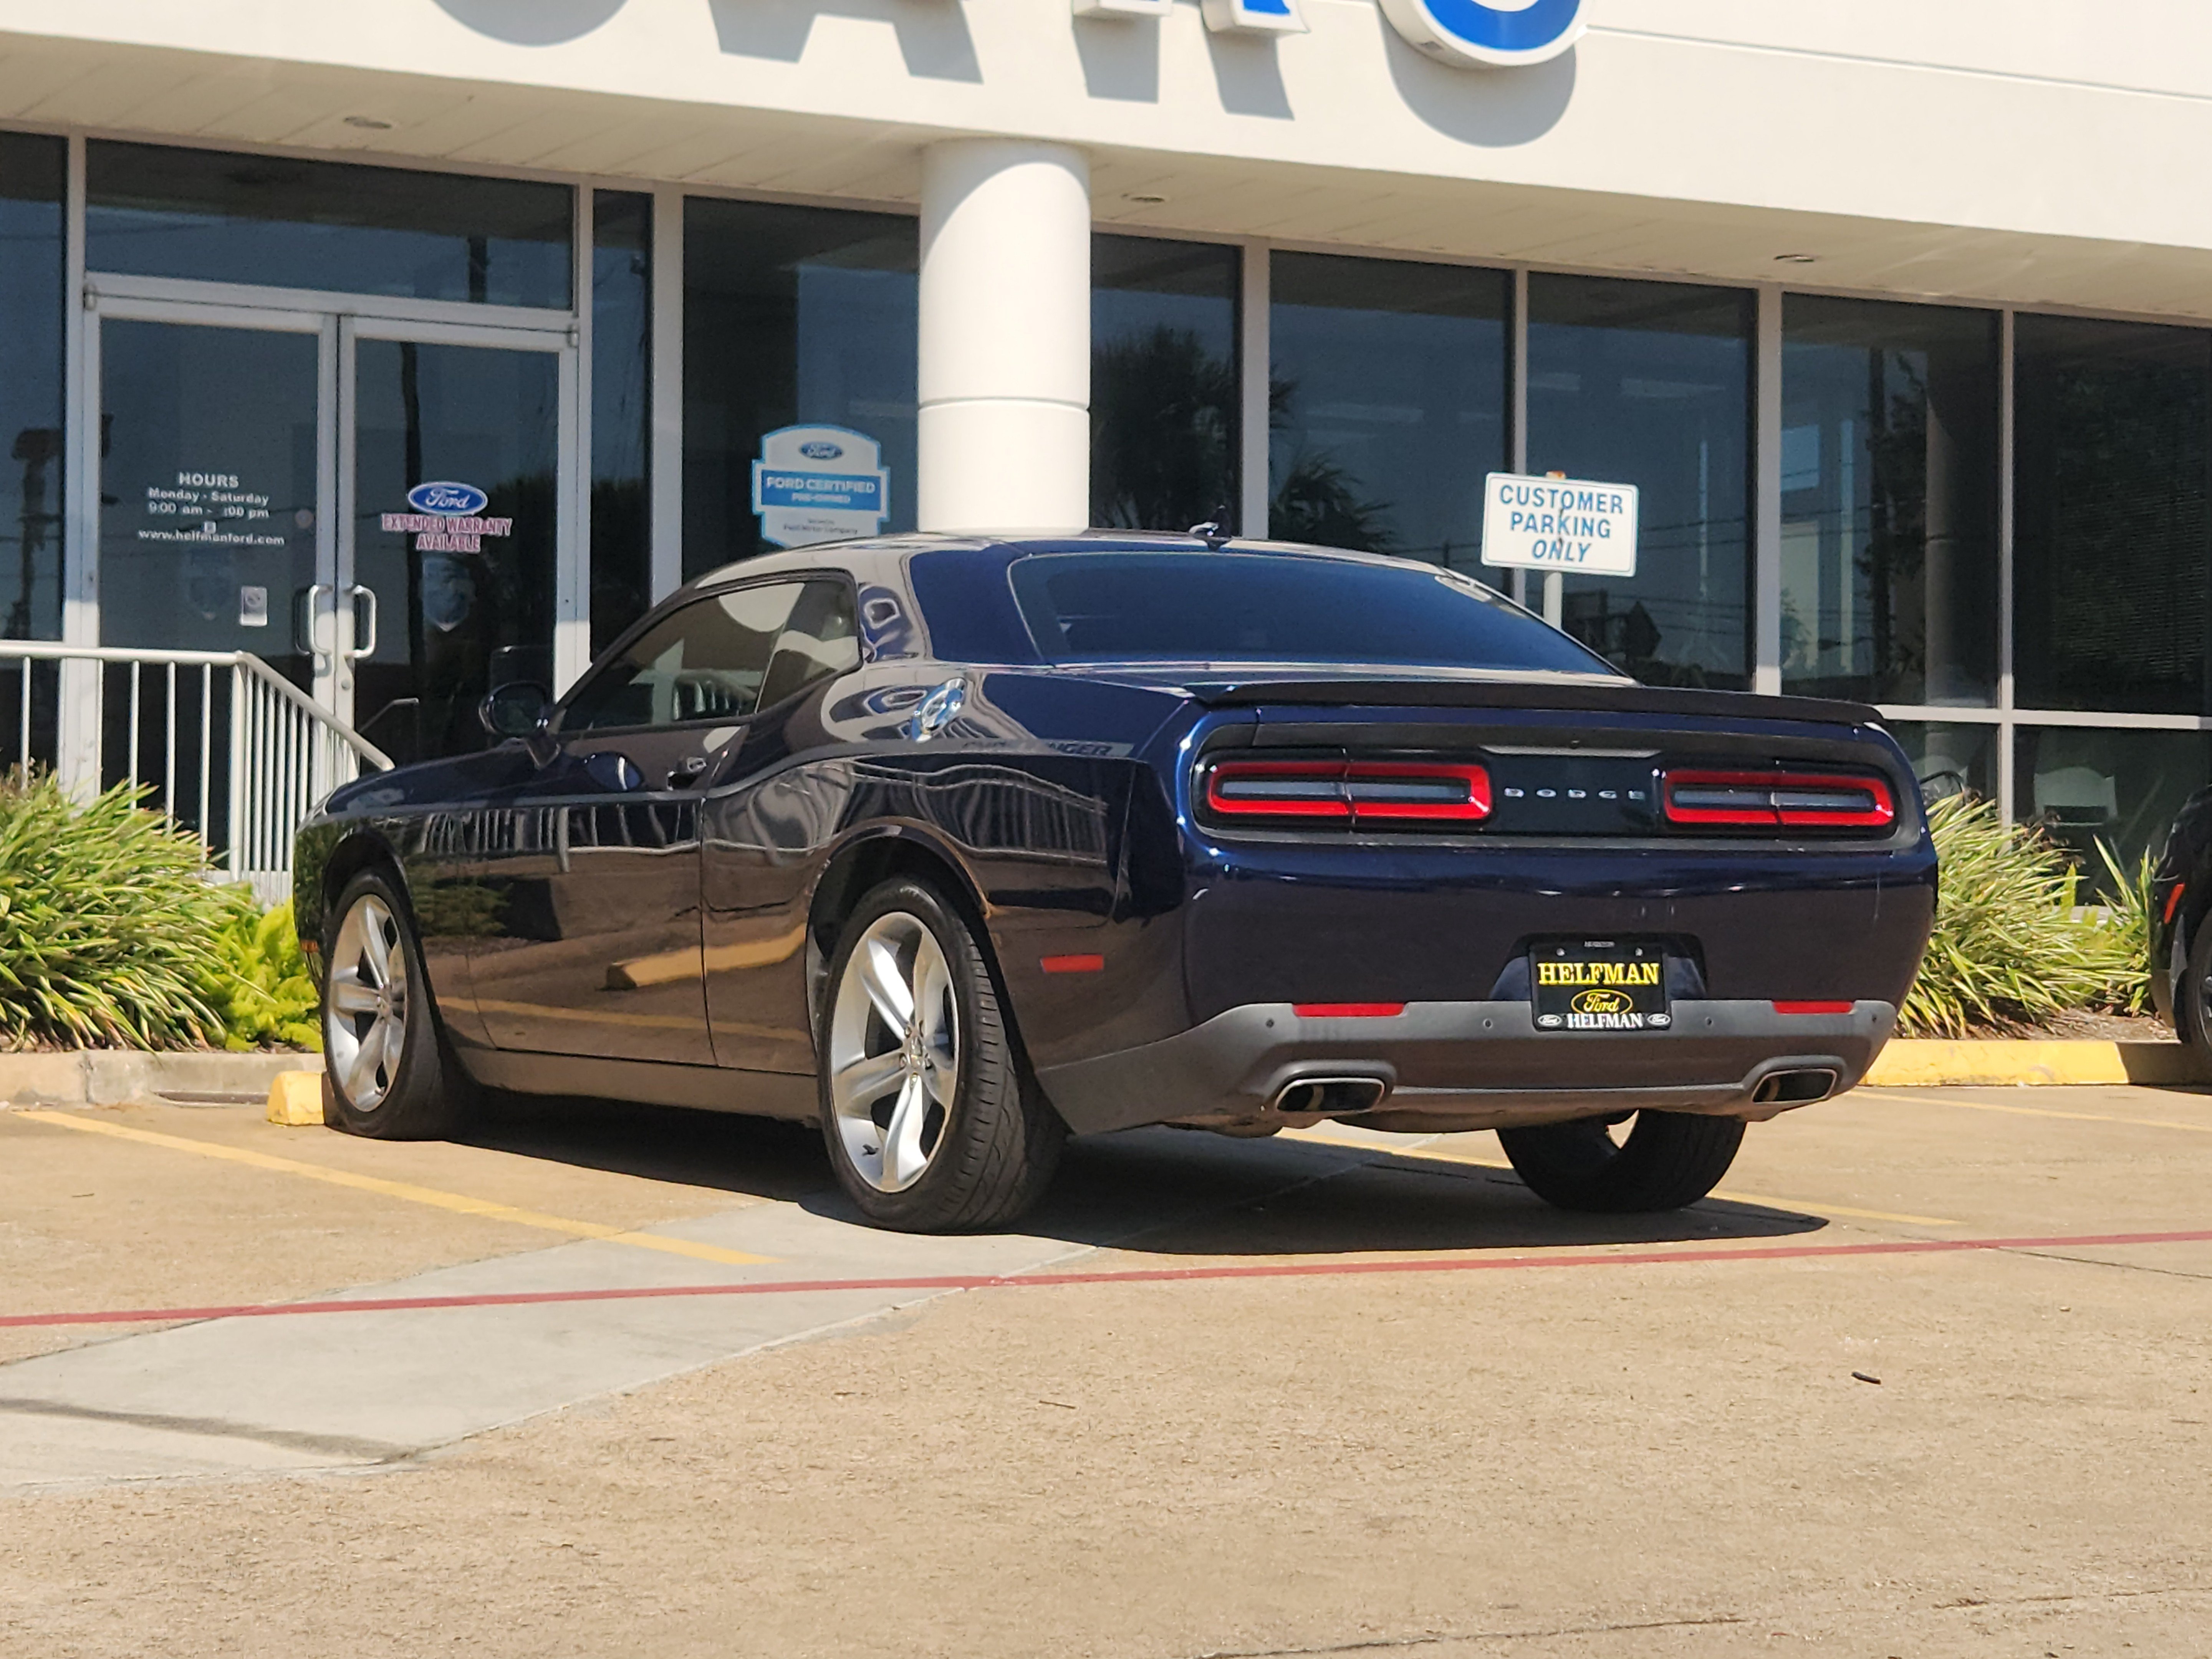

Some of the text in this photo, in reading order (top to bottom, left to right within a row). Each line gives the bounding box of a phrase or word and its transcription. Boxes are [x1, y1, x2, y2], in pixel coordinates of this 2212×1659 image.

[179, 472, 239, 488] HOURS
[766, 477, 876, 494] FORD CERTIFIED
[148, 488, 200, 503] Monday
[211, 490, 269, 506] Saturday
[424, 488, 470, 509] Ford
[1499, 485, 1623, 514] CUSTOMER
[182, 506, 203, 515] am
[249, 509, 269, 520] pm
[381, 513, 513, 536] EXTENDED WARRANTY
[1510, 512, 1611, 538] PARKING
[138, 529, 285, 545] www.helfmanford.com
[416, 533, 481, 552] AVAILABLE
[1532, 540, 1592, 563] ONLY
[1503, 788, 1646, 800] DODGE
[1537, 962, 1659, 986] HELFMAN
[1583, 993, 1620, 1013] Ford
[1567, 1013, 1643, 1028] HELFMAN
